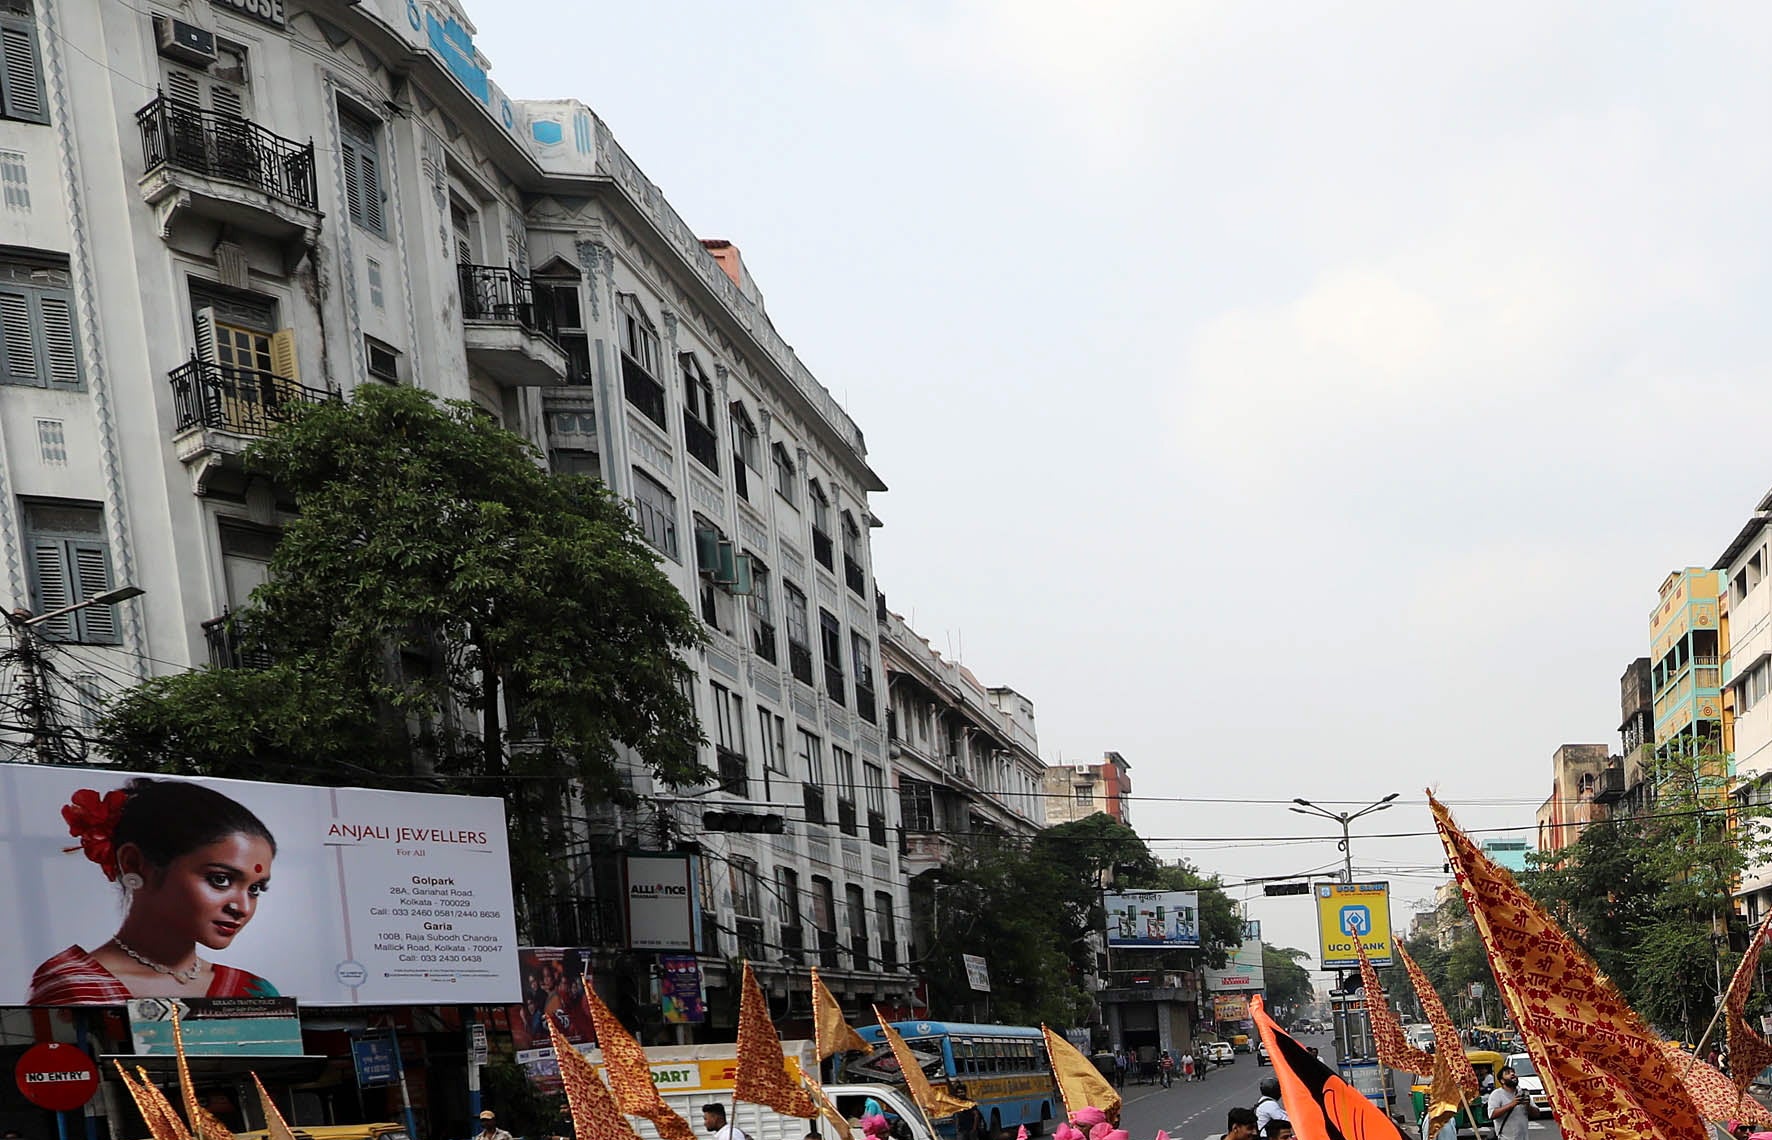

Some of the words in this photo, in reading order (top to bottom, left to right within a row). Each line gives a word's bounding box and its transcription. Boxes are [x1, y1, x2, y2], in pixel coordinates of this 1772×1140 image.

[328, 824, 389, 841] ANJALI
[395, 828, 487, 844] JEWELLERS
[412, 876, 454, 886] Golpark
[1477, 878, 1502, 897] राम
[412, 888, 448, 896] Gariahat
[400, 898, 432, 906] Kolkata
[424, 922, 452, 930] Garia
[1512, 910, 1529, 929] श्री
[406, 934, 424, 942] Raja
[427, 934, 461, 942] Subodh
[462, 934, 498, 942] Chandra
[434, 944, 465, 952] Kolkata
[1538, 939, 1562, 955] जय
[1535, 956, 1555, 972] श्री
[1526, 971, 1552, 988] राम
[1560, 987, 1586, 1002] जय
[1565, 1002, 1580, 1019] श्री
[1561, 1016, 1587, 1035] राम
[29, 1073, 43, 1081] NO
[49, 1072, 82, 1080] ENTRY
[1580, 1076, 1605, 1091] राम
[1590, 1118, 1616, 1132] जय
